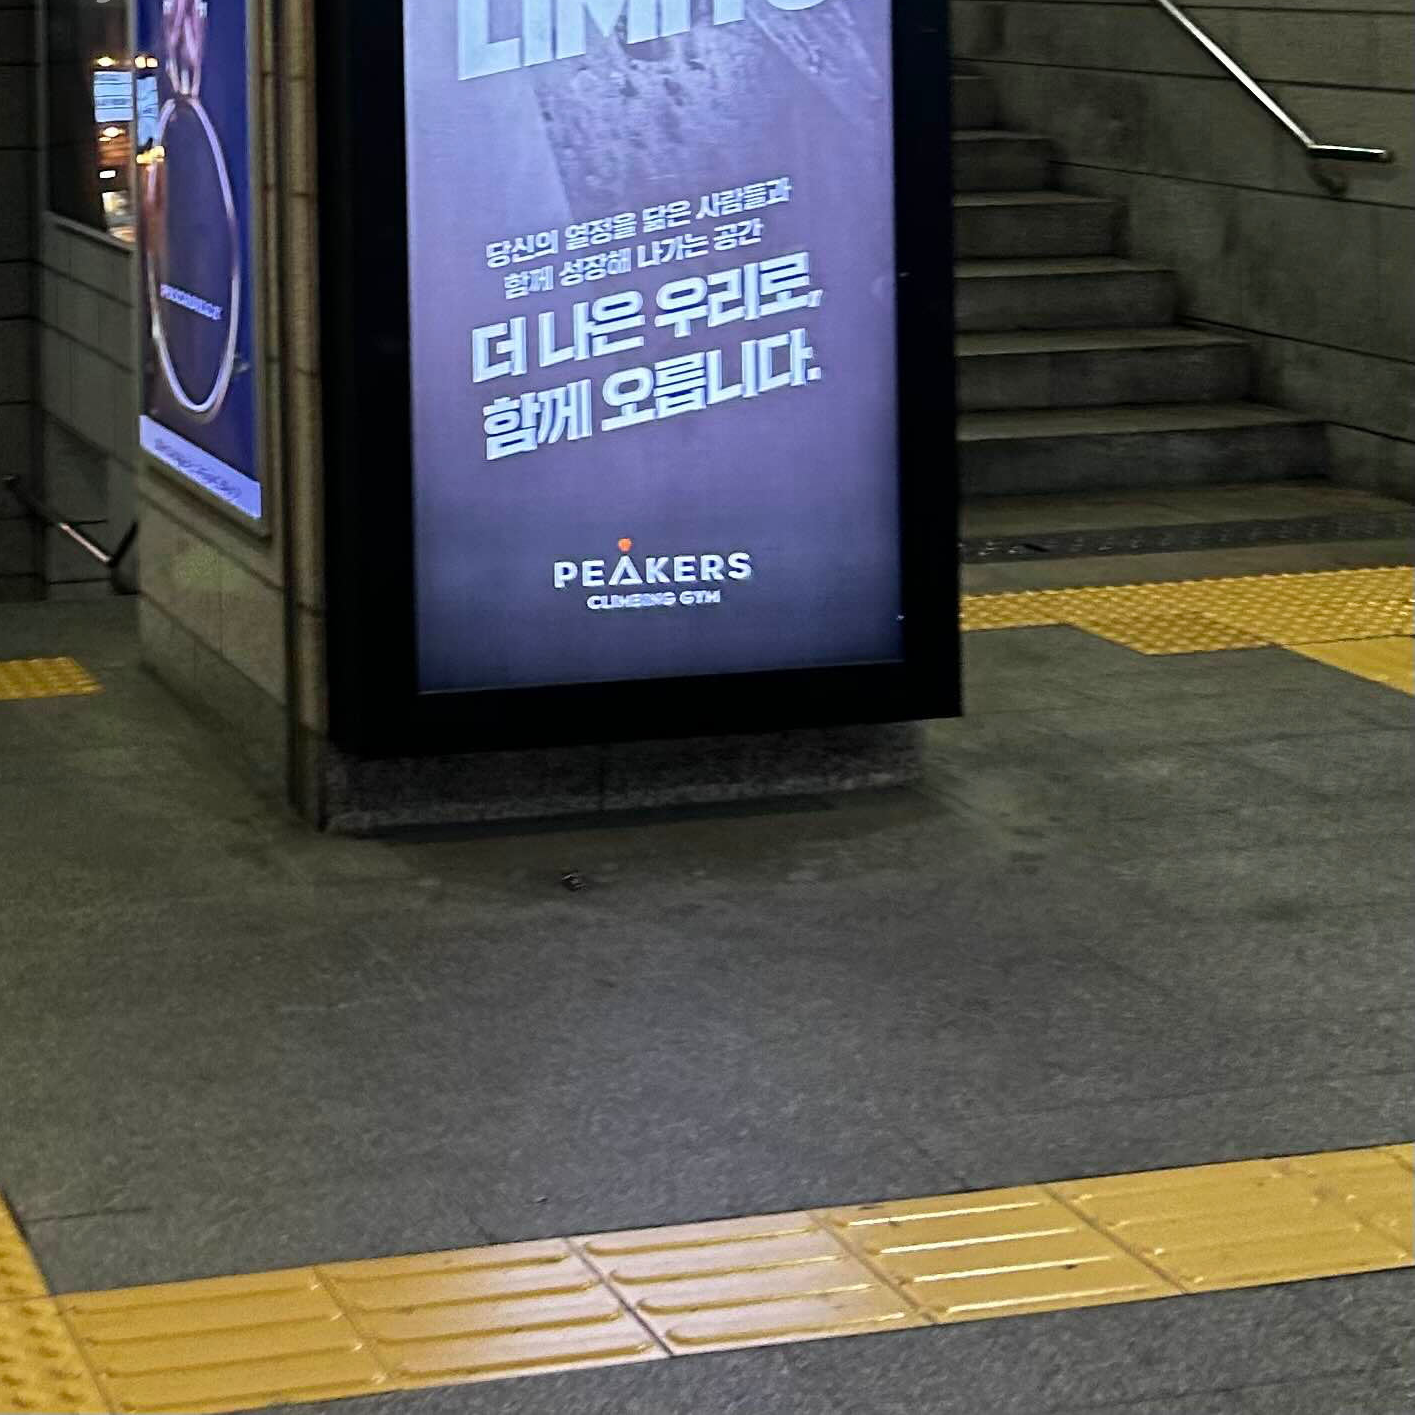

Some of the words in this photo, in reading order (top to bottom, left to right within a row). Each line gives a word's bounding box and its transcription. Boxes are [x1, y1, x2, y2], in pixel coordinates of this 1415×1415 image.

[486, 229, 559, 269] 당신의
[564, 211, 637, 251] 열정을
[695, 176, 793, 220] 사람들과
[504, 265, 554, 300] 함께
[559, 247, 632, 288] 성장해
[636, 232, 709, 268] 나가는
[713, 217, 764, 251] 공간
[472, 315, 528, 384] 더
[537, 289, 646, 368] 나은
[654, 250, 824, 339] 우리로,
[482, 377, 593, 462] 함께
[553, 550, 753, 589] PEAKERS
[586, 590, 677, 610] CLIMBING
